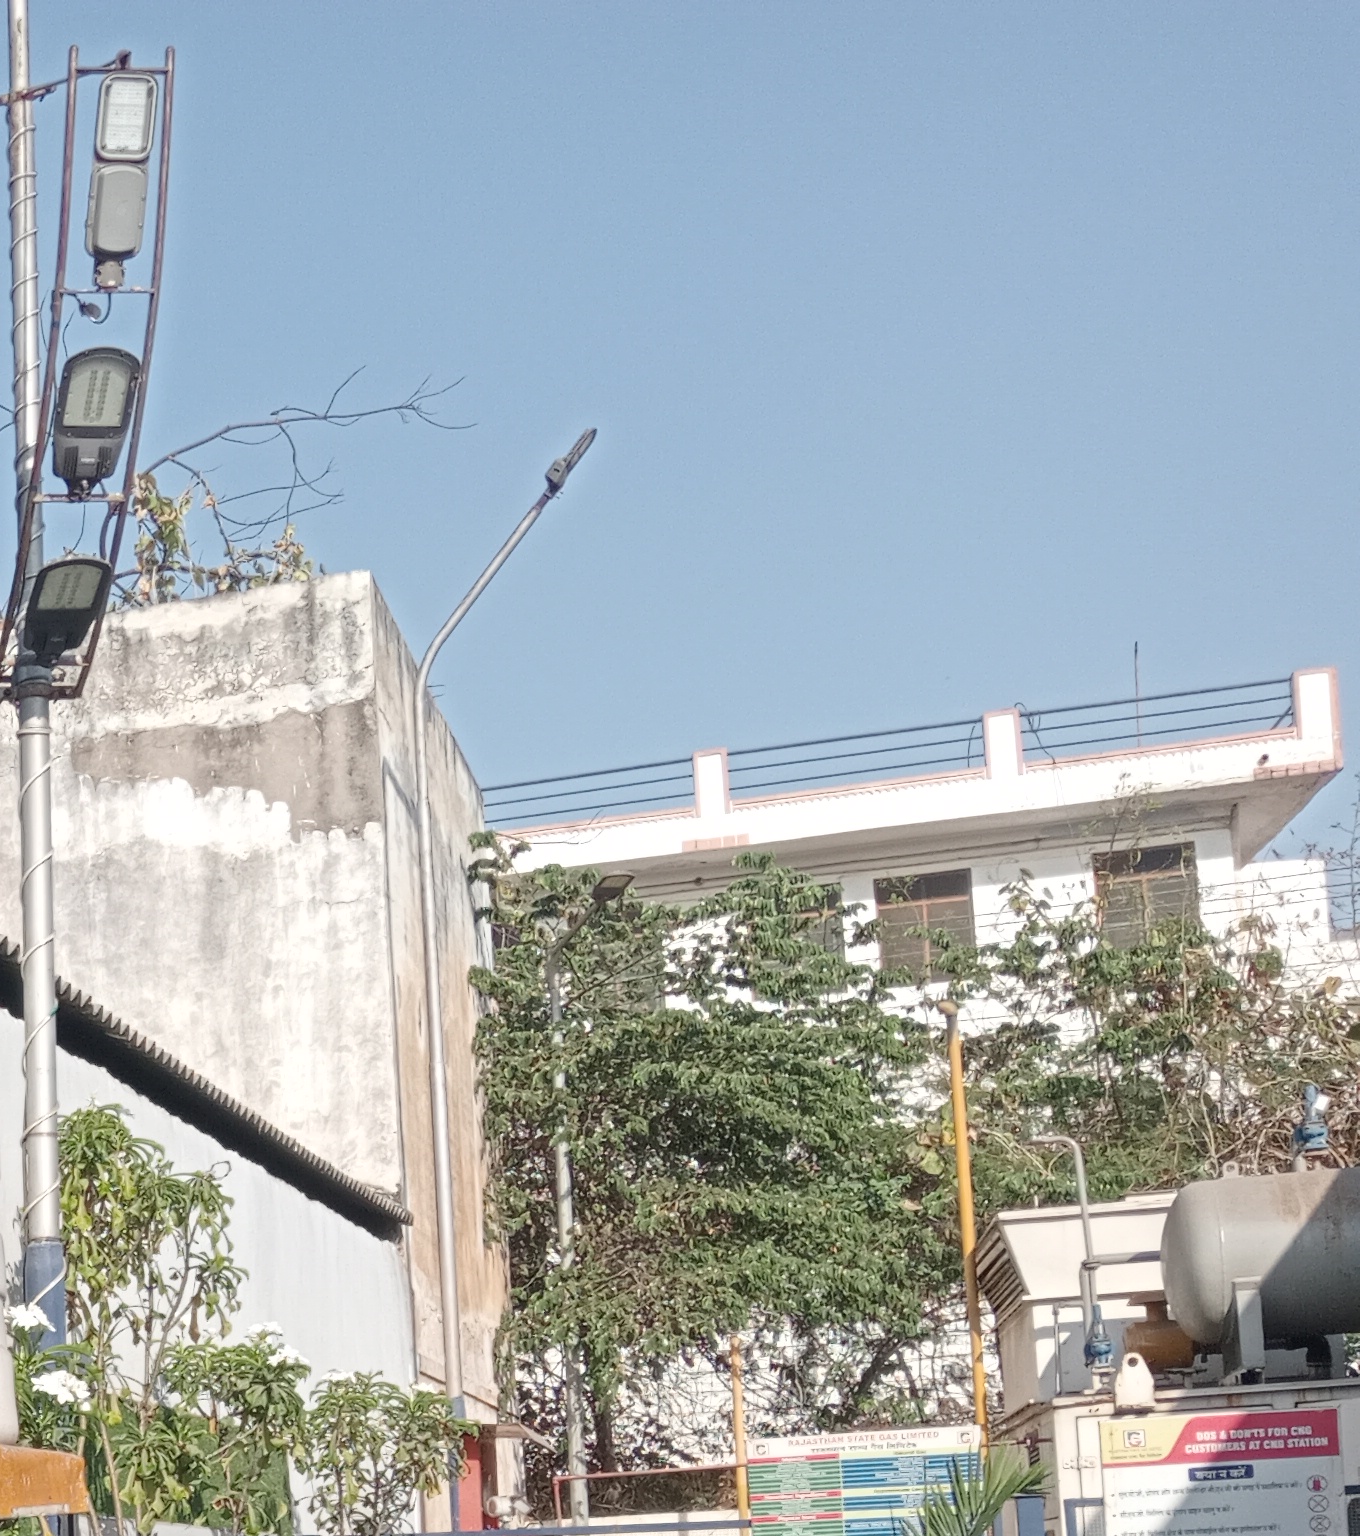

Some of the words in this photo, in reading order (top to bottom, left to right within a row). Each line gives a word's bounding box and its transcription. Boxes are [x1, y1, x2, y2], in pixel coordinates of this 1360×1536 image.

[1267, 1427, 1288, 1438] FOR
[788, 1436, 844, 1447] RAJASTHAN
[847, 1434, 875, 1443] STATE
[878, 1432, 898, 1442] GAS
[901, 1431, 940, 1440] LIMITED
[1287, 1437, 1329, 1448] STATION
